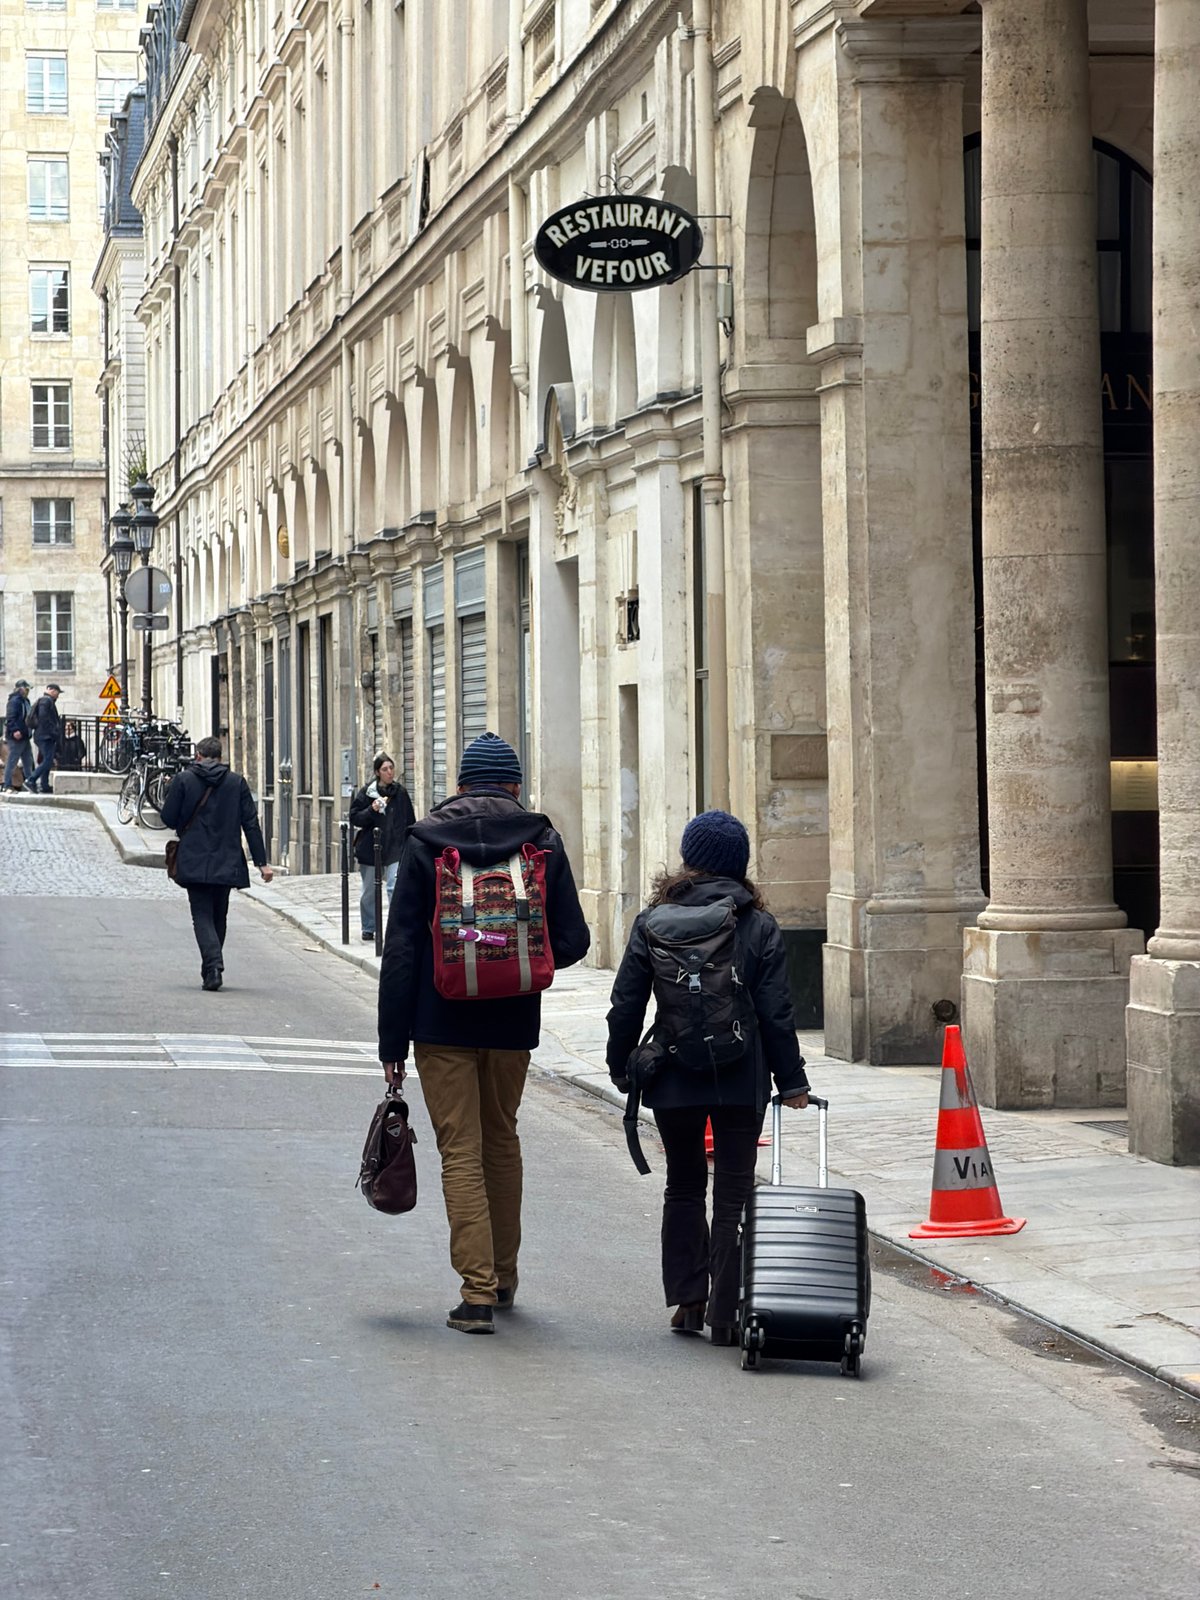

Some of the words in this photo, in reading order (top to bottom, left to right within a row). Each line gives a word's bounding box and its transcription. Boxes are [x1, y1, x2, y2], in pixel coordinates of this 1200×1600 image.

[545, 203, 691, 248] RESTAURANT
[576, 251, 672, 284] VEFOUR
[953, 1155, 993, 1180] VIA
